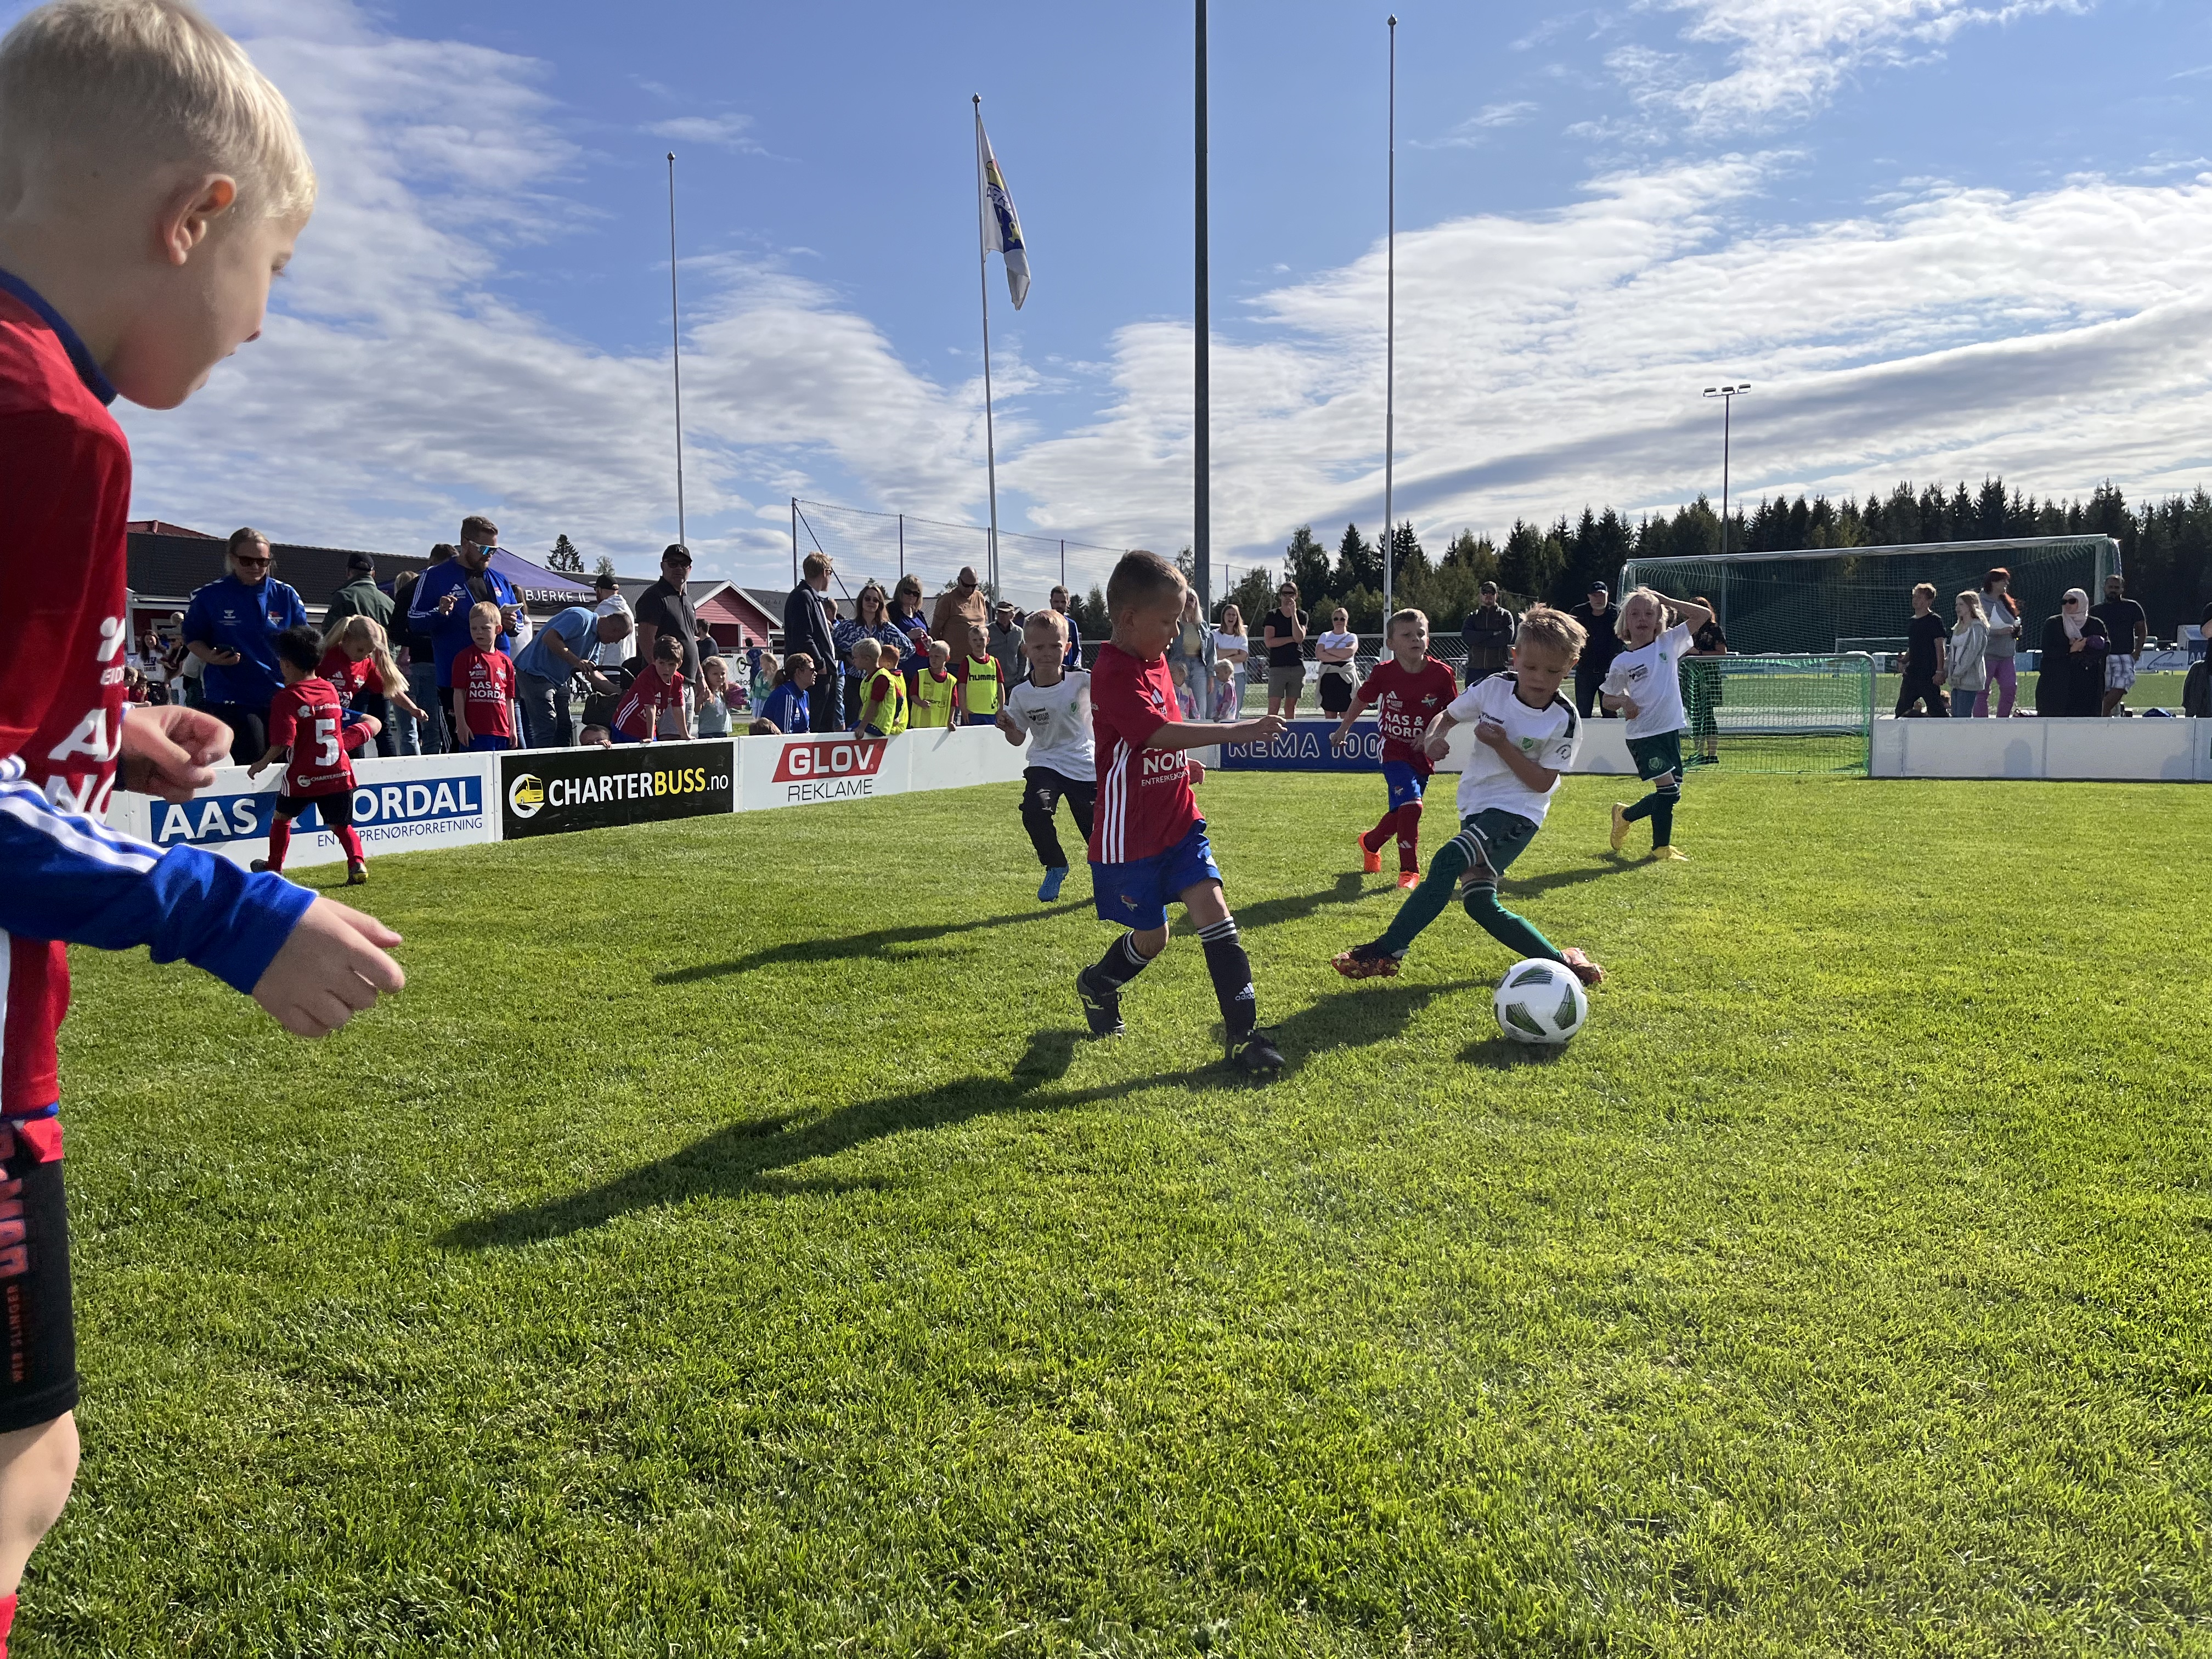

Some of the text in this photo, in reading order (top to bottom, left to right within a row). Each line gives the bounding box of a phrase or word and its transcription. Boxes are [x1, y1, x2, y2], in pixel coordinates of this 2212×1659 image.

[525, 590, 590, 603] BJERKE IL
[100, 665, 125, 685] EID
[469, 681, 492, 689] AAS
[469, 690, 506, 699] NORDA
[1385, 711, 1424, 726] AAS &
[315, 719, 340, 766] 5
[1228, 732, 1380, 758] REMA 100
[789, 744, 874, 775] GLOV
[1143, 749, 1188, 775] NOR
[549, 768, 729, 806] CHARTERBUSS.no
[788, 778, 873, 802] REKLAME
[158, 798, 258, 843] AAS
[318, 817, 483, 847] ENPRENØRFORRETNING
[1235, 992, 1255, 1001] adida
